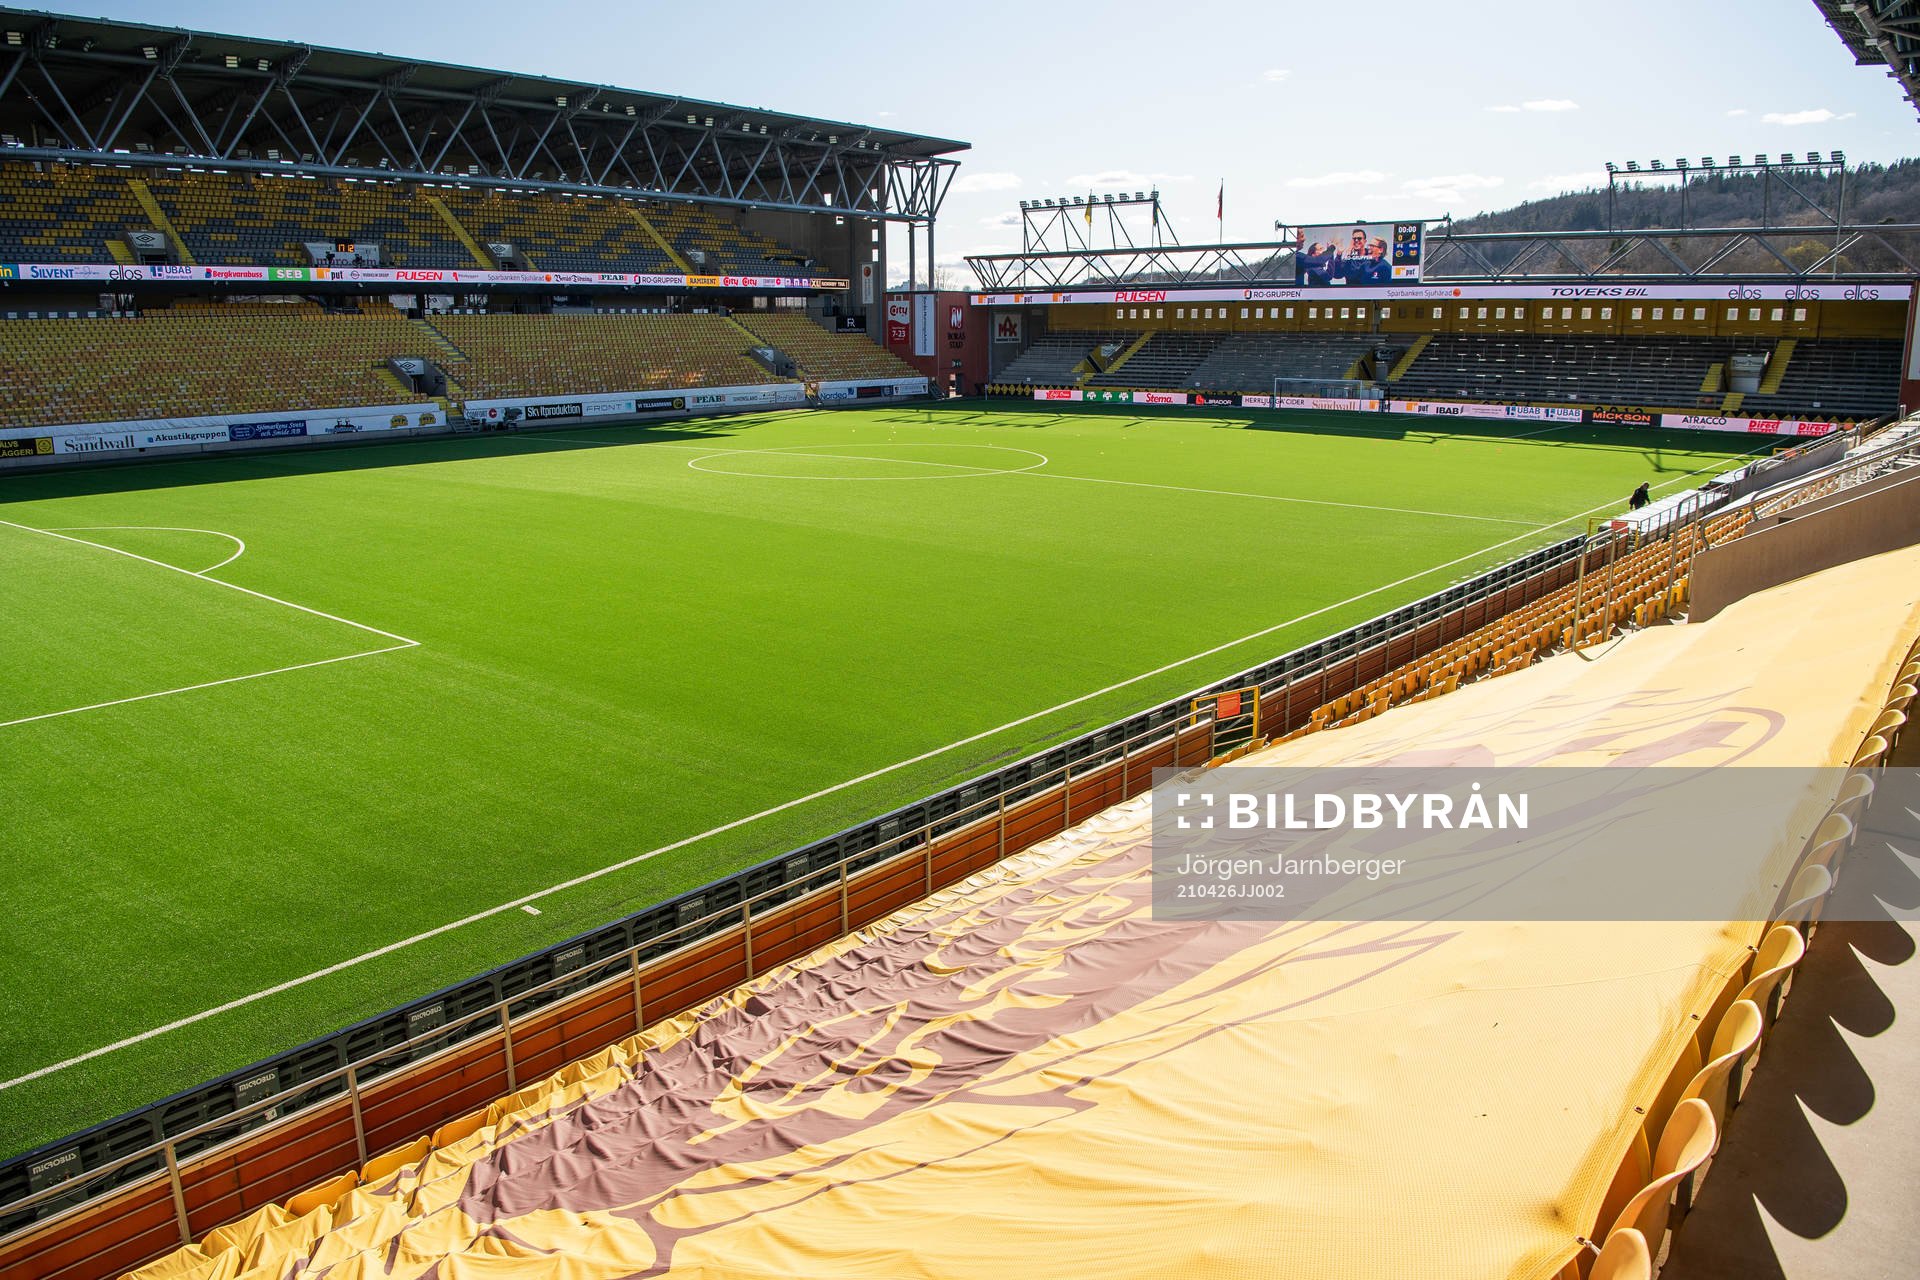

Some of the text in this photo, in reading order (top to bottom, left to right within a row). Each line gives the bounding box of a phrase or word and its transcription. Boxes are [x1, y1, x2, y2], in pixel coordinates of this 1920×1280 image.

[109, 264, 143, 280] ellos
[164, 265, 192, 275] UBAB
[276, 269, 303, 279] SEB
[395, 271, 443, 281] PULSEN
[487, 273, 520, 282] Sparbanken
[642, 276, 682, 284] RO-GRUPPEN
[1114, 290, 1167, 303] PULSEN
[1253, 290, 1301, 298] RO-GRUPPEN
[1386, 289, 1424, 298] Sparbanken
[1550, 287, 1650, 297] TOVEKS BIL
[1728, 284, 1762, 300] ellos
[1784, 284, 1820, 300] ellos
[1844, 284, 1879, 300] ellos
[998, 315, 1018, 337] MAX
[696, 395, 722, 404] PEAB
[820, 391, 848, 400] Nordea
[586, 404, 623, 412] FRONT
[1311, 400, 1357, 411] Sandwall
[1435, 406, 1460, 415] IBAB
[1517, 406, 1541, 415] UBAB
[1556, 408, 1581, 417] UBAB
[1681, 414, 1727, 426] ATRACCO
[154, 430, 228, 442] Akustikgruppen
[63, 434, 136, 453] Sandwall
[239, 1073, 276, 1092] MICROBUS
[32, 1152, 77, 1175] MICROBUS
